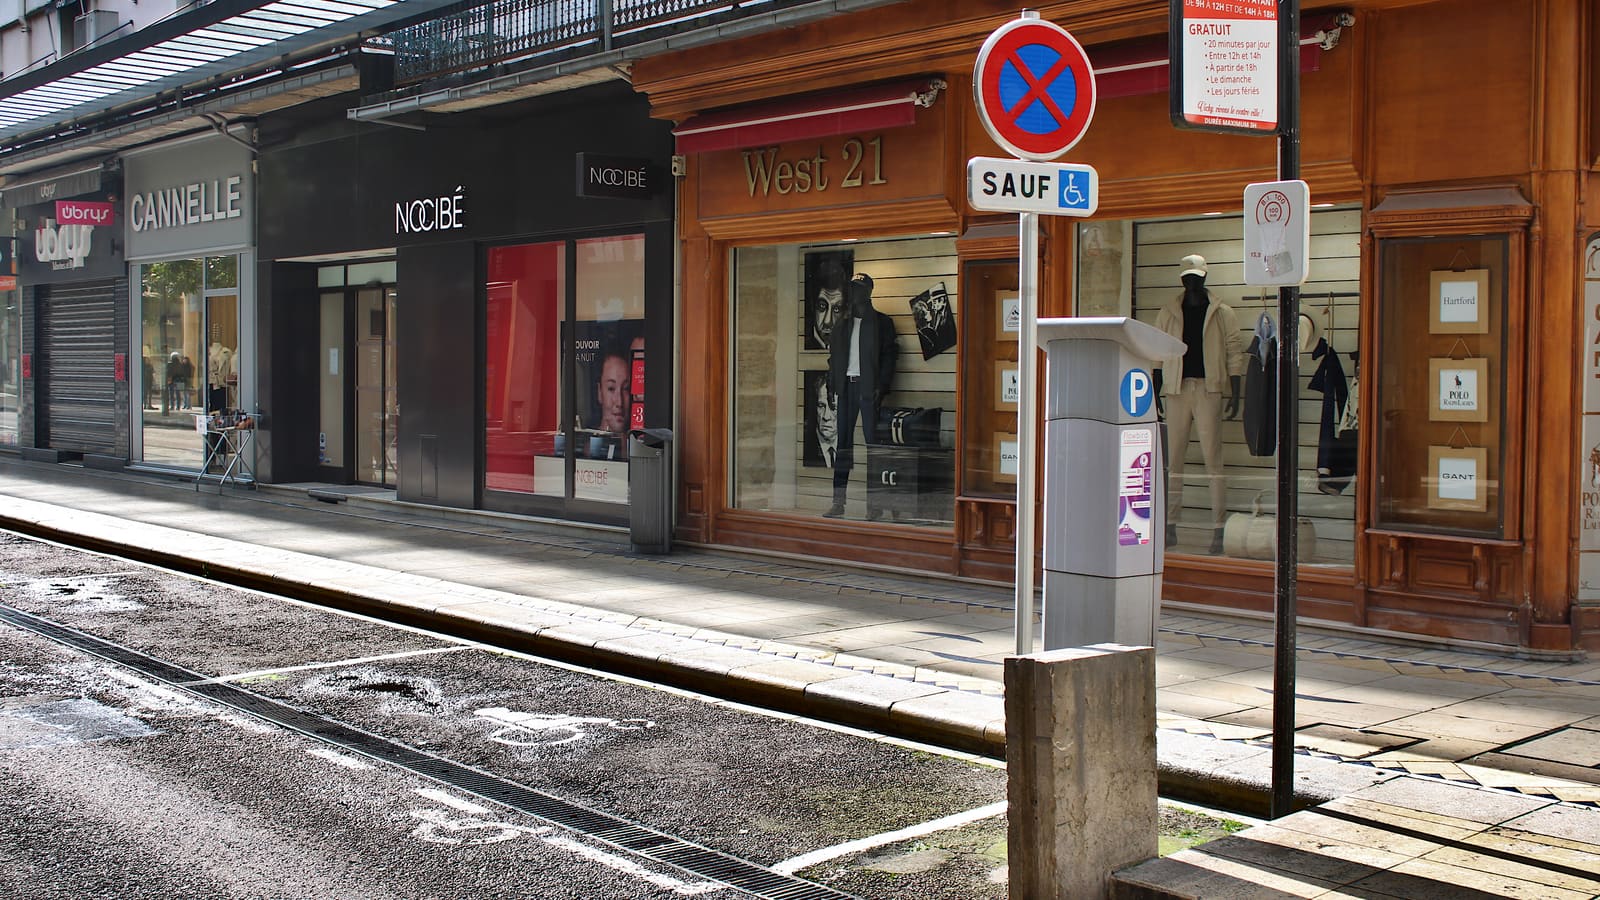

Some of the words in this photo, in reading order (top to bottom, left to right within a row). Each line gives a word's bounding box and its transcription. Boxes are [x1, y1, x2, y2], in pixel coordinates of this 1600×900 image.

[1212, 2, 1224, 11] 12H
[1226, 4, 1233, 12] ET
[1244, 7, 1256, 16] 14H
[1264, 10, 1275, 18] 18H
[1189, 24, 1231, 35] GRATUIT
[1218, 40, 1244, 48] minutes
[1246, 42, 1256, 50] par
[1258, 41, 1270, 50] jour
[1216, 64, 1234, 73] partir
[1224, 87, 1240, 97] jours
[1242, 87, 1260, 95] fériés
[742, 144, 828, 197] West
[841, 136, 887, 188] 21
[590, 167, 646, 188] NOCIBÉ
[982, 172, 1050, 199] SAUF
[132, 176, 240, 232] CANNELLE
[396, 186, 463, 234] NOCIBÉ
[1443, 296, 1475, 304] Hartford
[576, 340, 600, 350] OUVOIR
[581, 353, 595, 362] NUIT
[1130, 372, 1149, 414] P
[1450, 391, 1469, 400] POLO
[576, 468, 608, 485] NOCIBÉ
